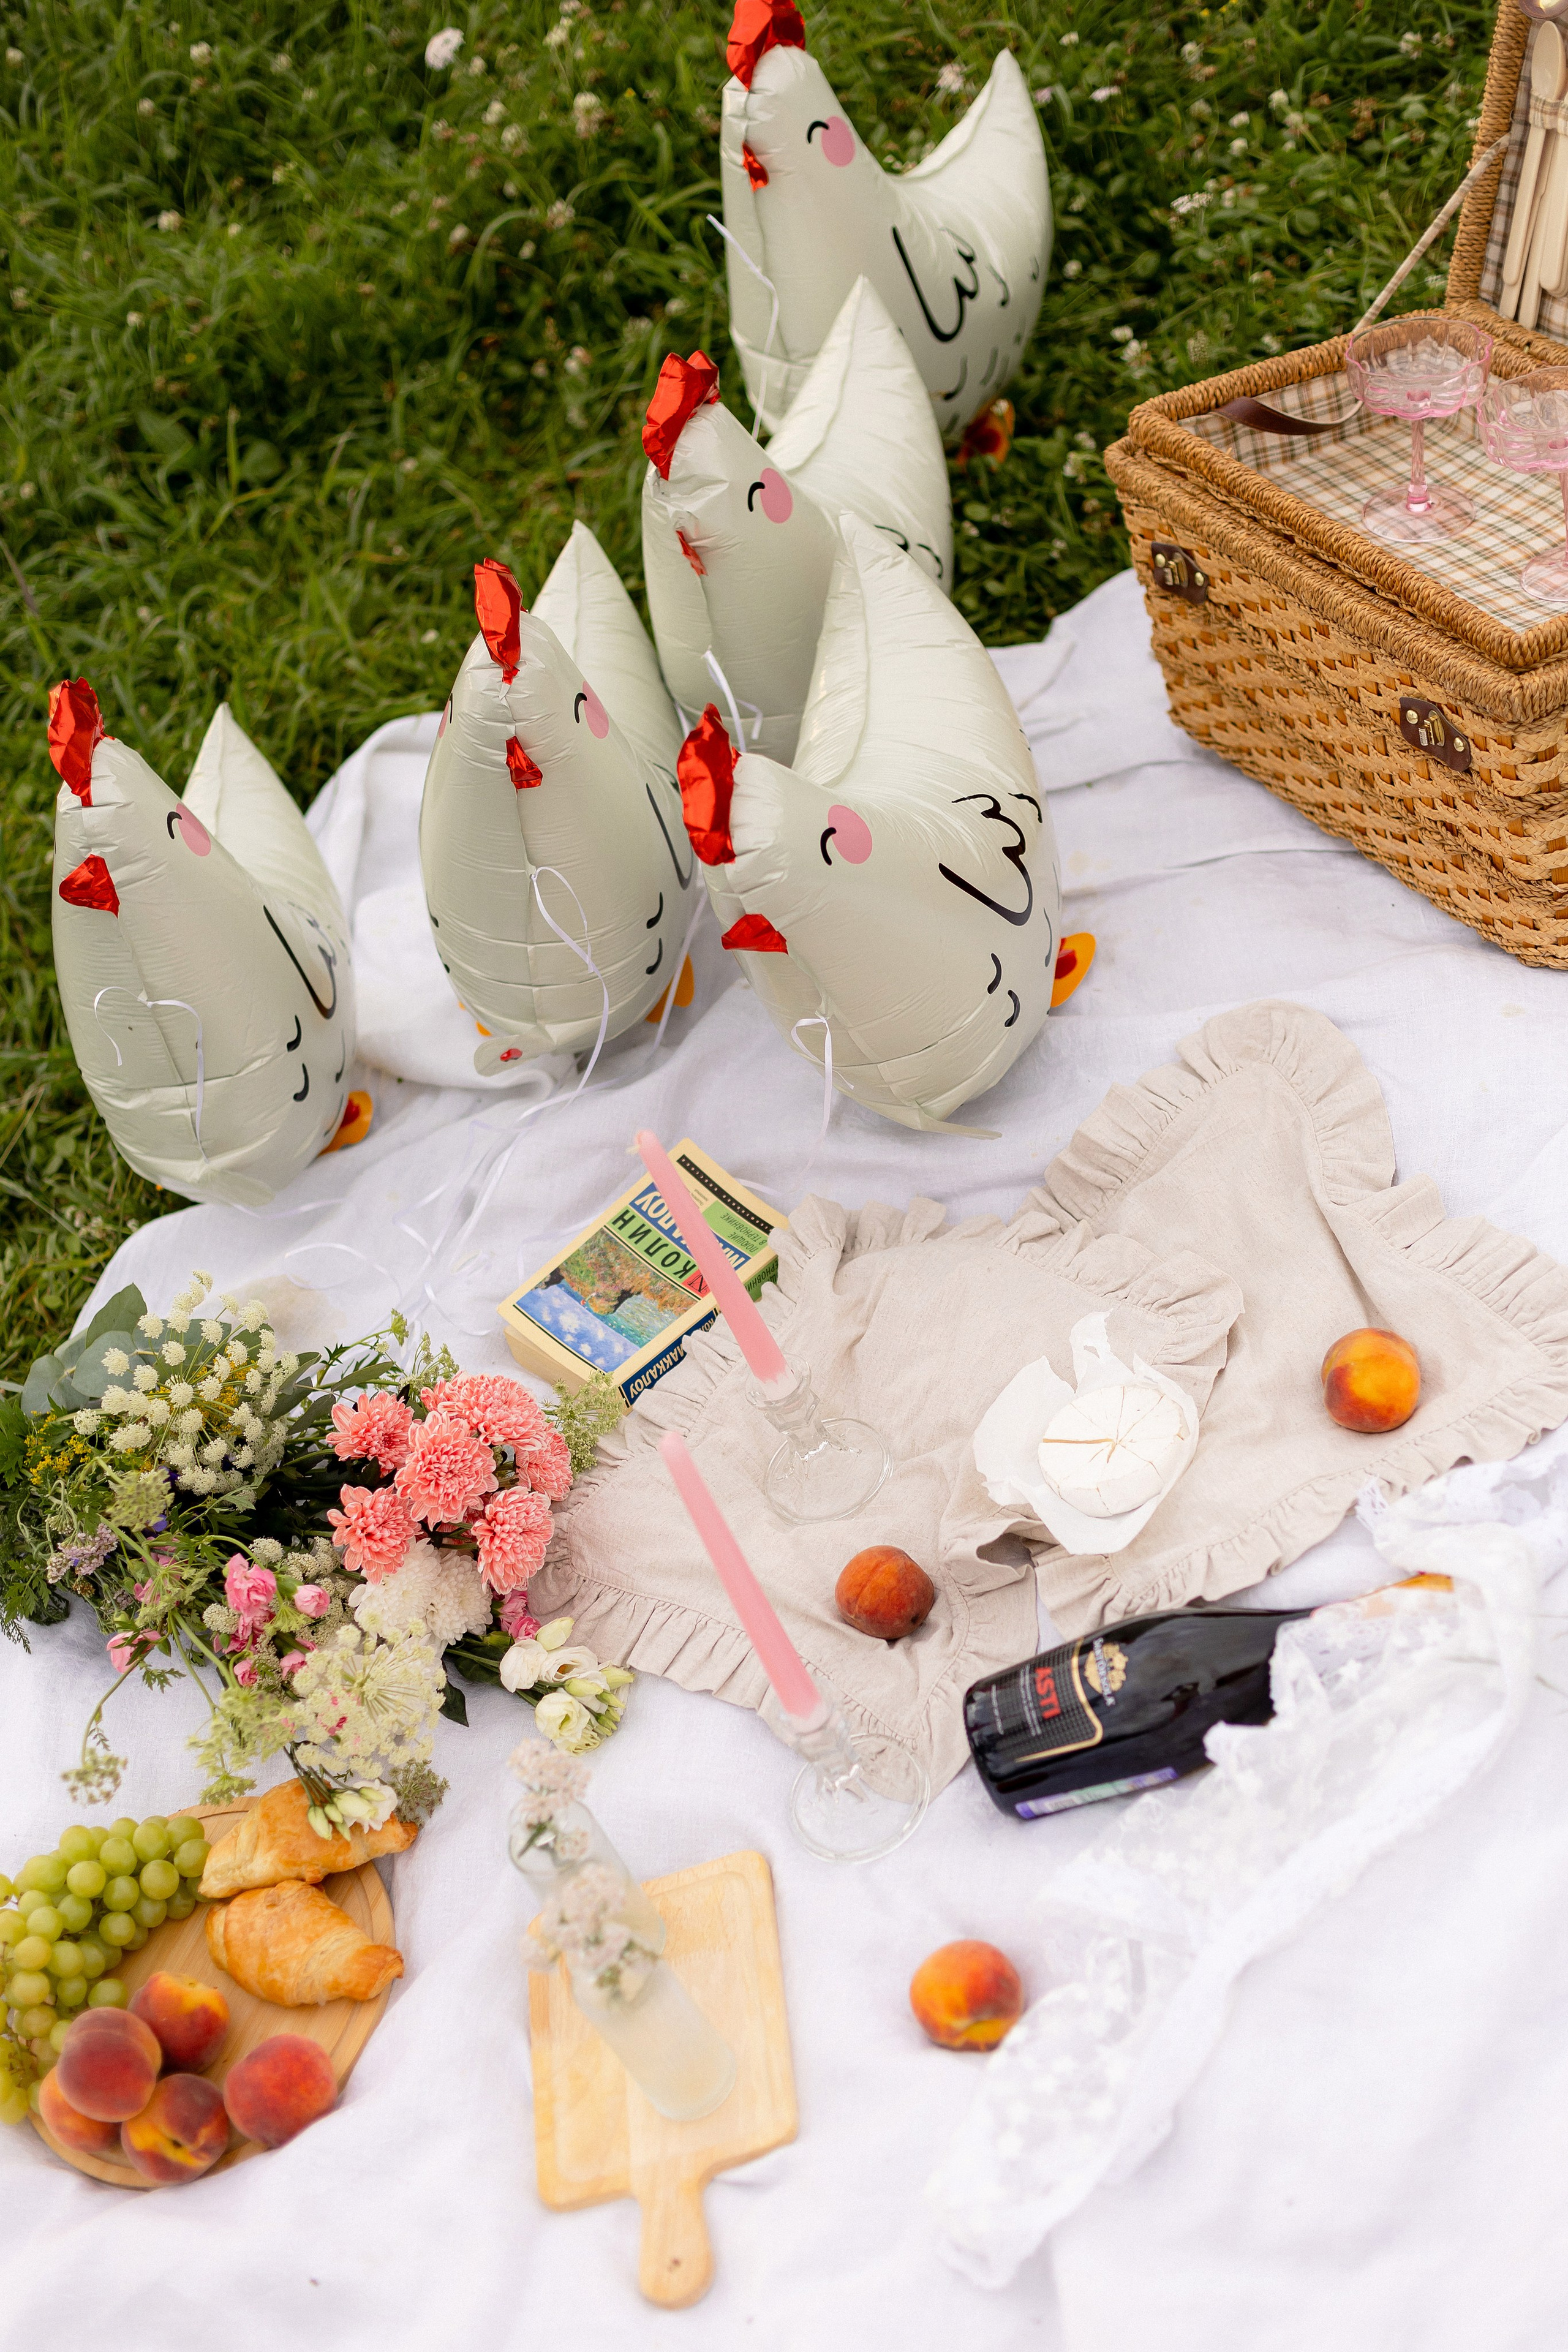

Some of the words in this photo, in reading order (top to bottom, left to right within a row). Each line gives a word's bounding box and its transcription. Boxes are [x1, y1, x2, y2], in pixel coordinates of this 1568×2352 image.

[720, 1212, 761, 1242] ТЕРНОВНИКЕ
[728, 1232, 759, 1253] ПОЮЩИЕ
[611, 1209, 697, 1279] КОЛИН
[745, 1260, 778, 1292] ЕРНОВНИ
[1035, 1667, 1062, 1719] ASTI
